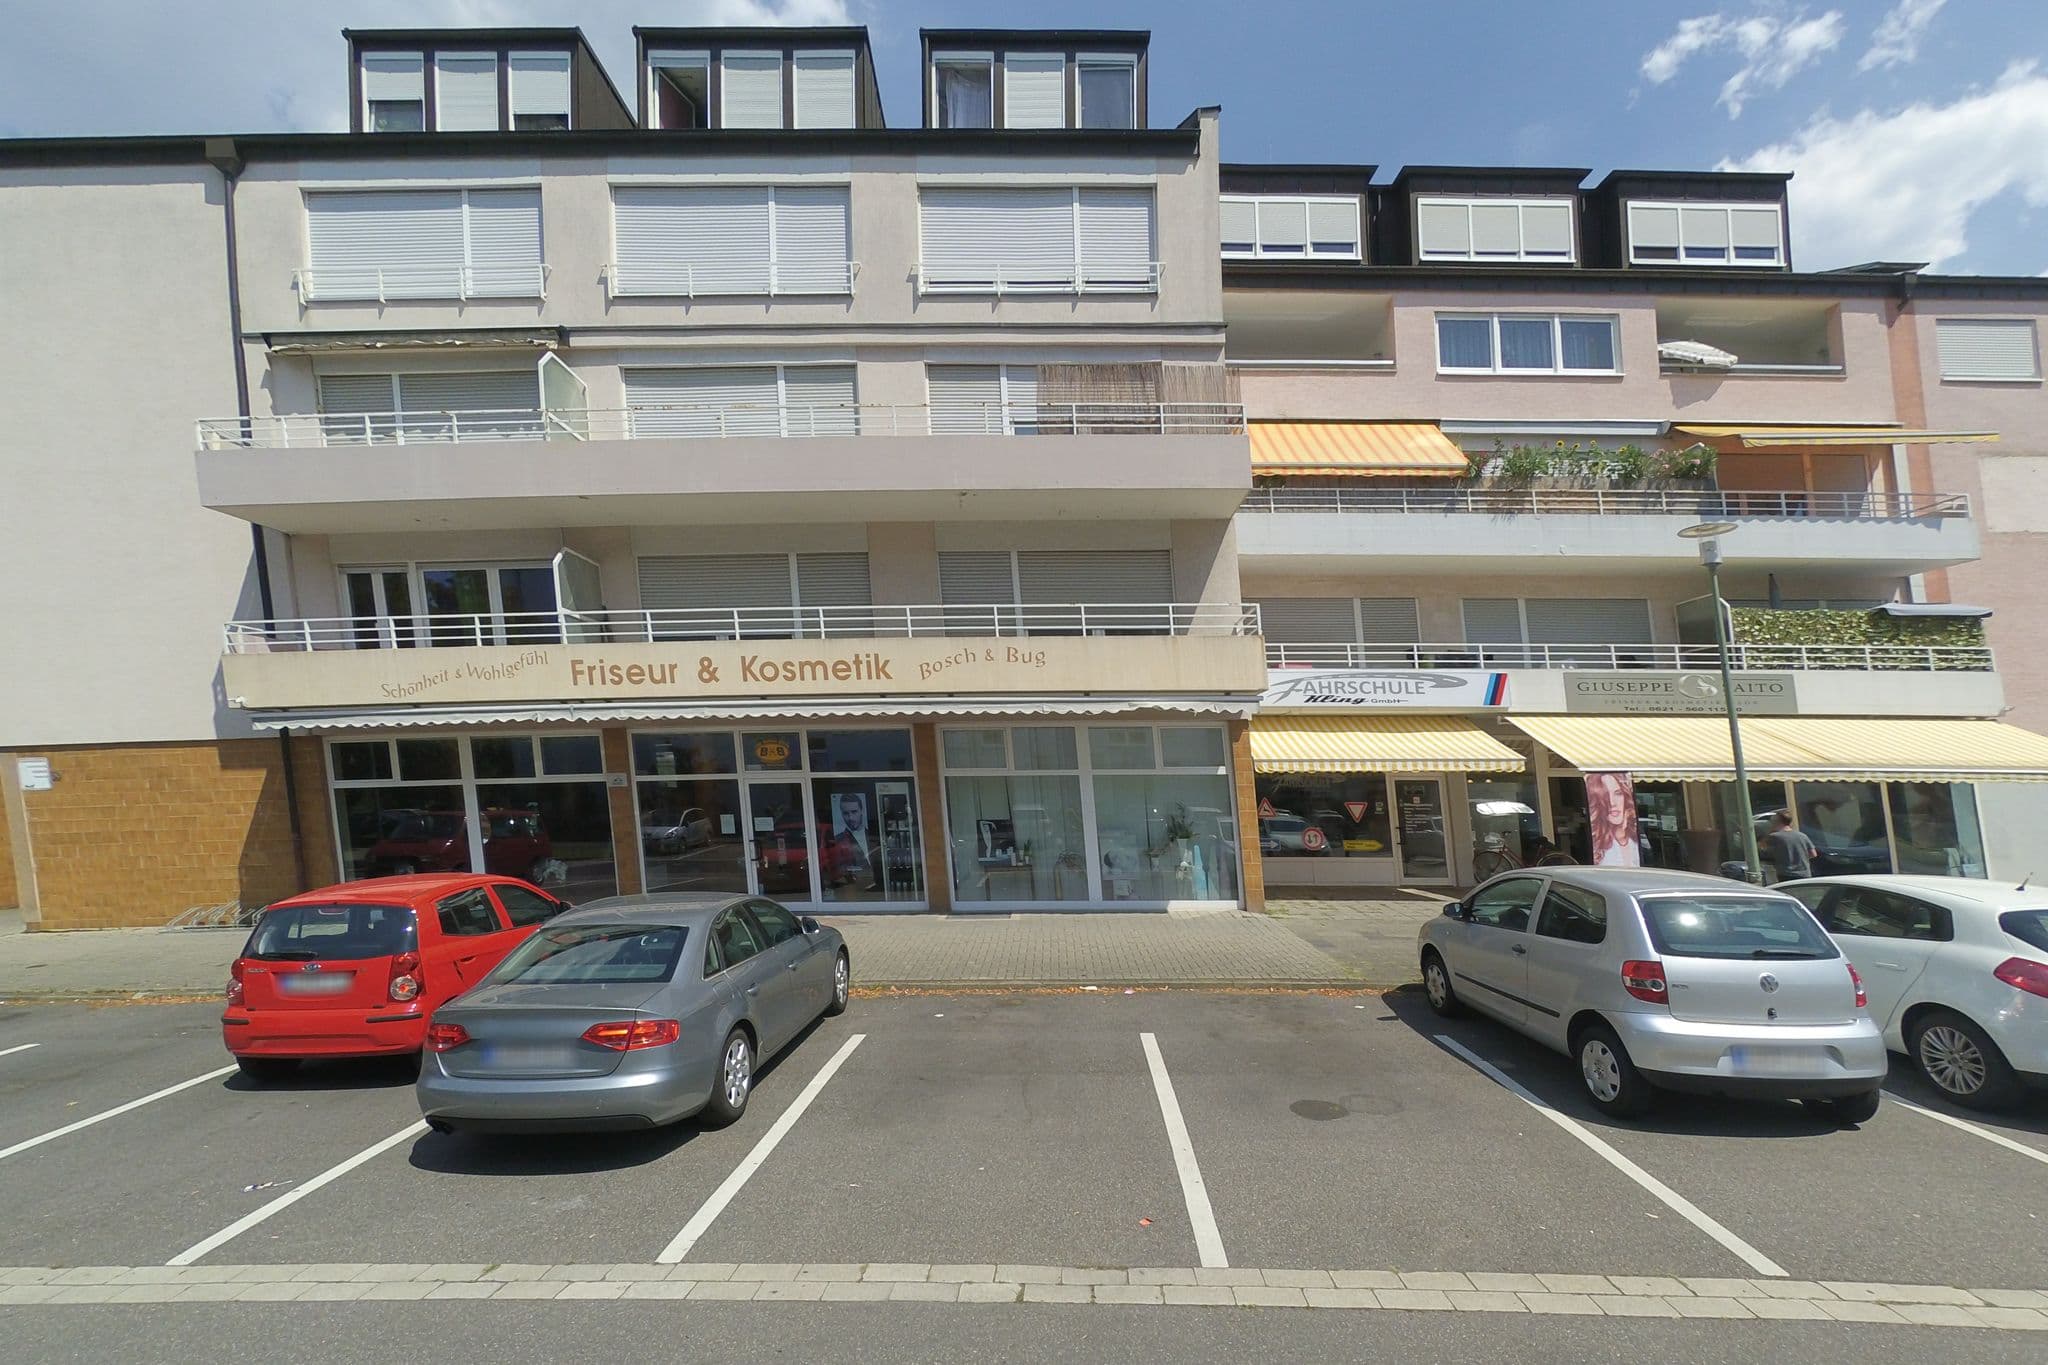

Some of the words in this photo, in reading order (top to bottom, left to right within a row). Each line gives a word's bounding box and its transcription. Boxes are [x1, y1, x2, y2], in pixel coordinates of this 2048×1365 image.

[380, 669, 449, 698] Schönheit
[465, 651, 549, 682] Wohlgefühl
[570, 658, 678, 686] Friseur
[697, 656, 720, 684] &
[740, 653, 893, 683] Kosmetik
[919, 648, 976, 681] Bosch
[984, 647, 995, 662] &
[1006, 646, 1047, 668] Bug
[1268, 676, 1426, 704] FAHRSCHULE
[1303, 694, 1367, 705] Kling
[1370, 697, 1401, 705] GmbH
[1577, 681, 1674, 692] GIUSEPPE
[1733, 683, 1784, 693] AITO
